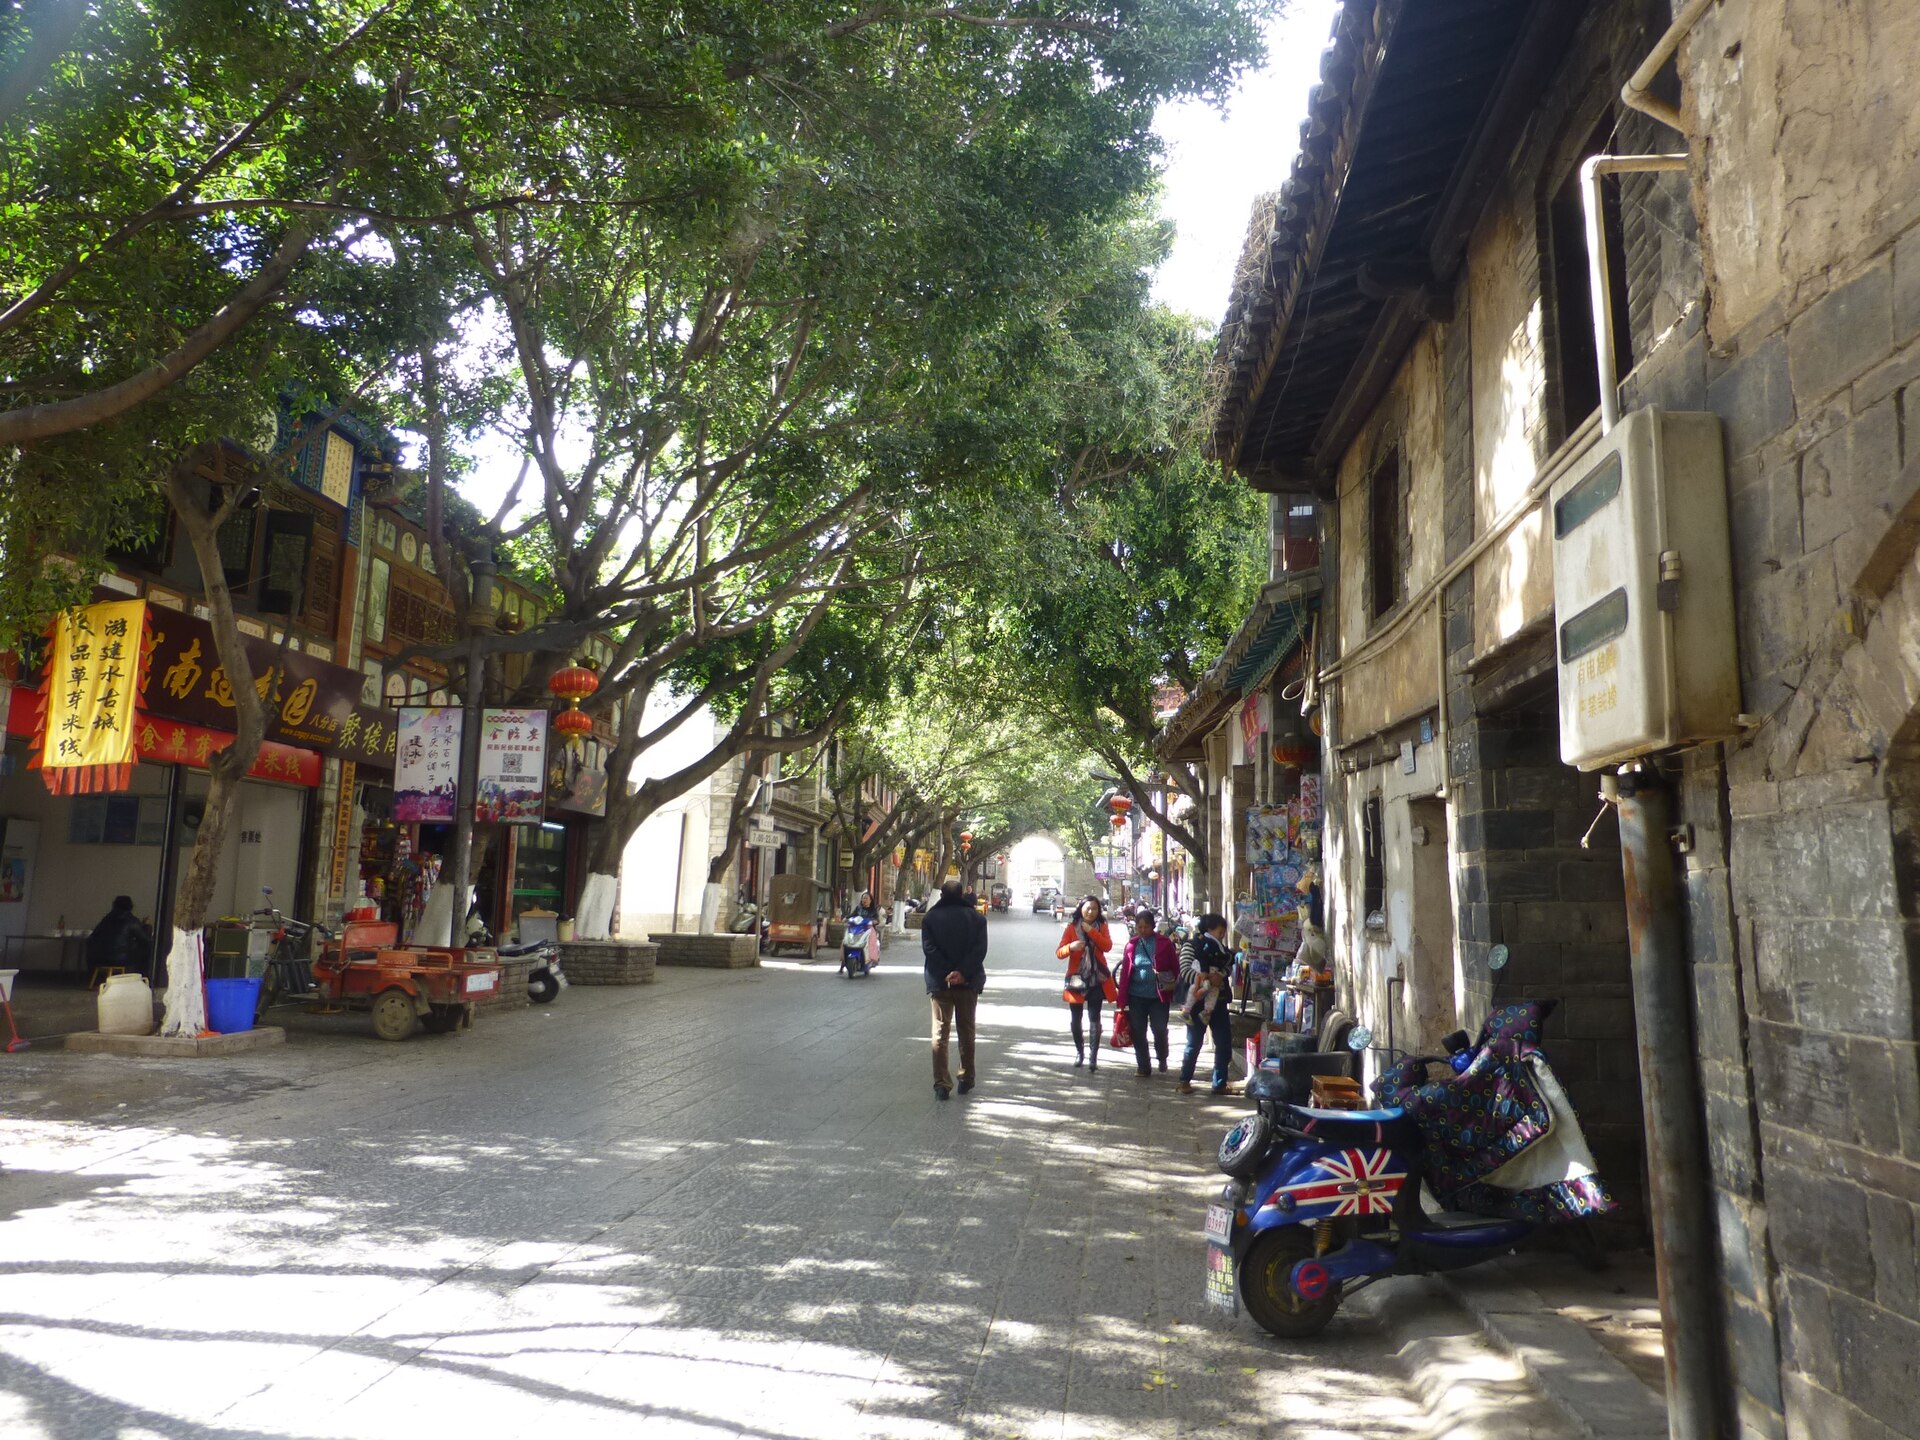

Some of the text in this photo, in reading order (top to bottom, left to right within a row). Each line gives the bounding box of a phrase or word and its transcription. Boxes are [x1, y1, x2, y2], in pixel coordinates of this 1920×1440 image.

[93, 618, 128, 732] 游建水古城
